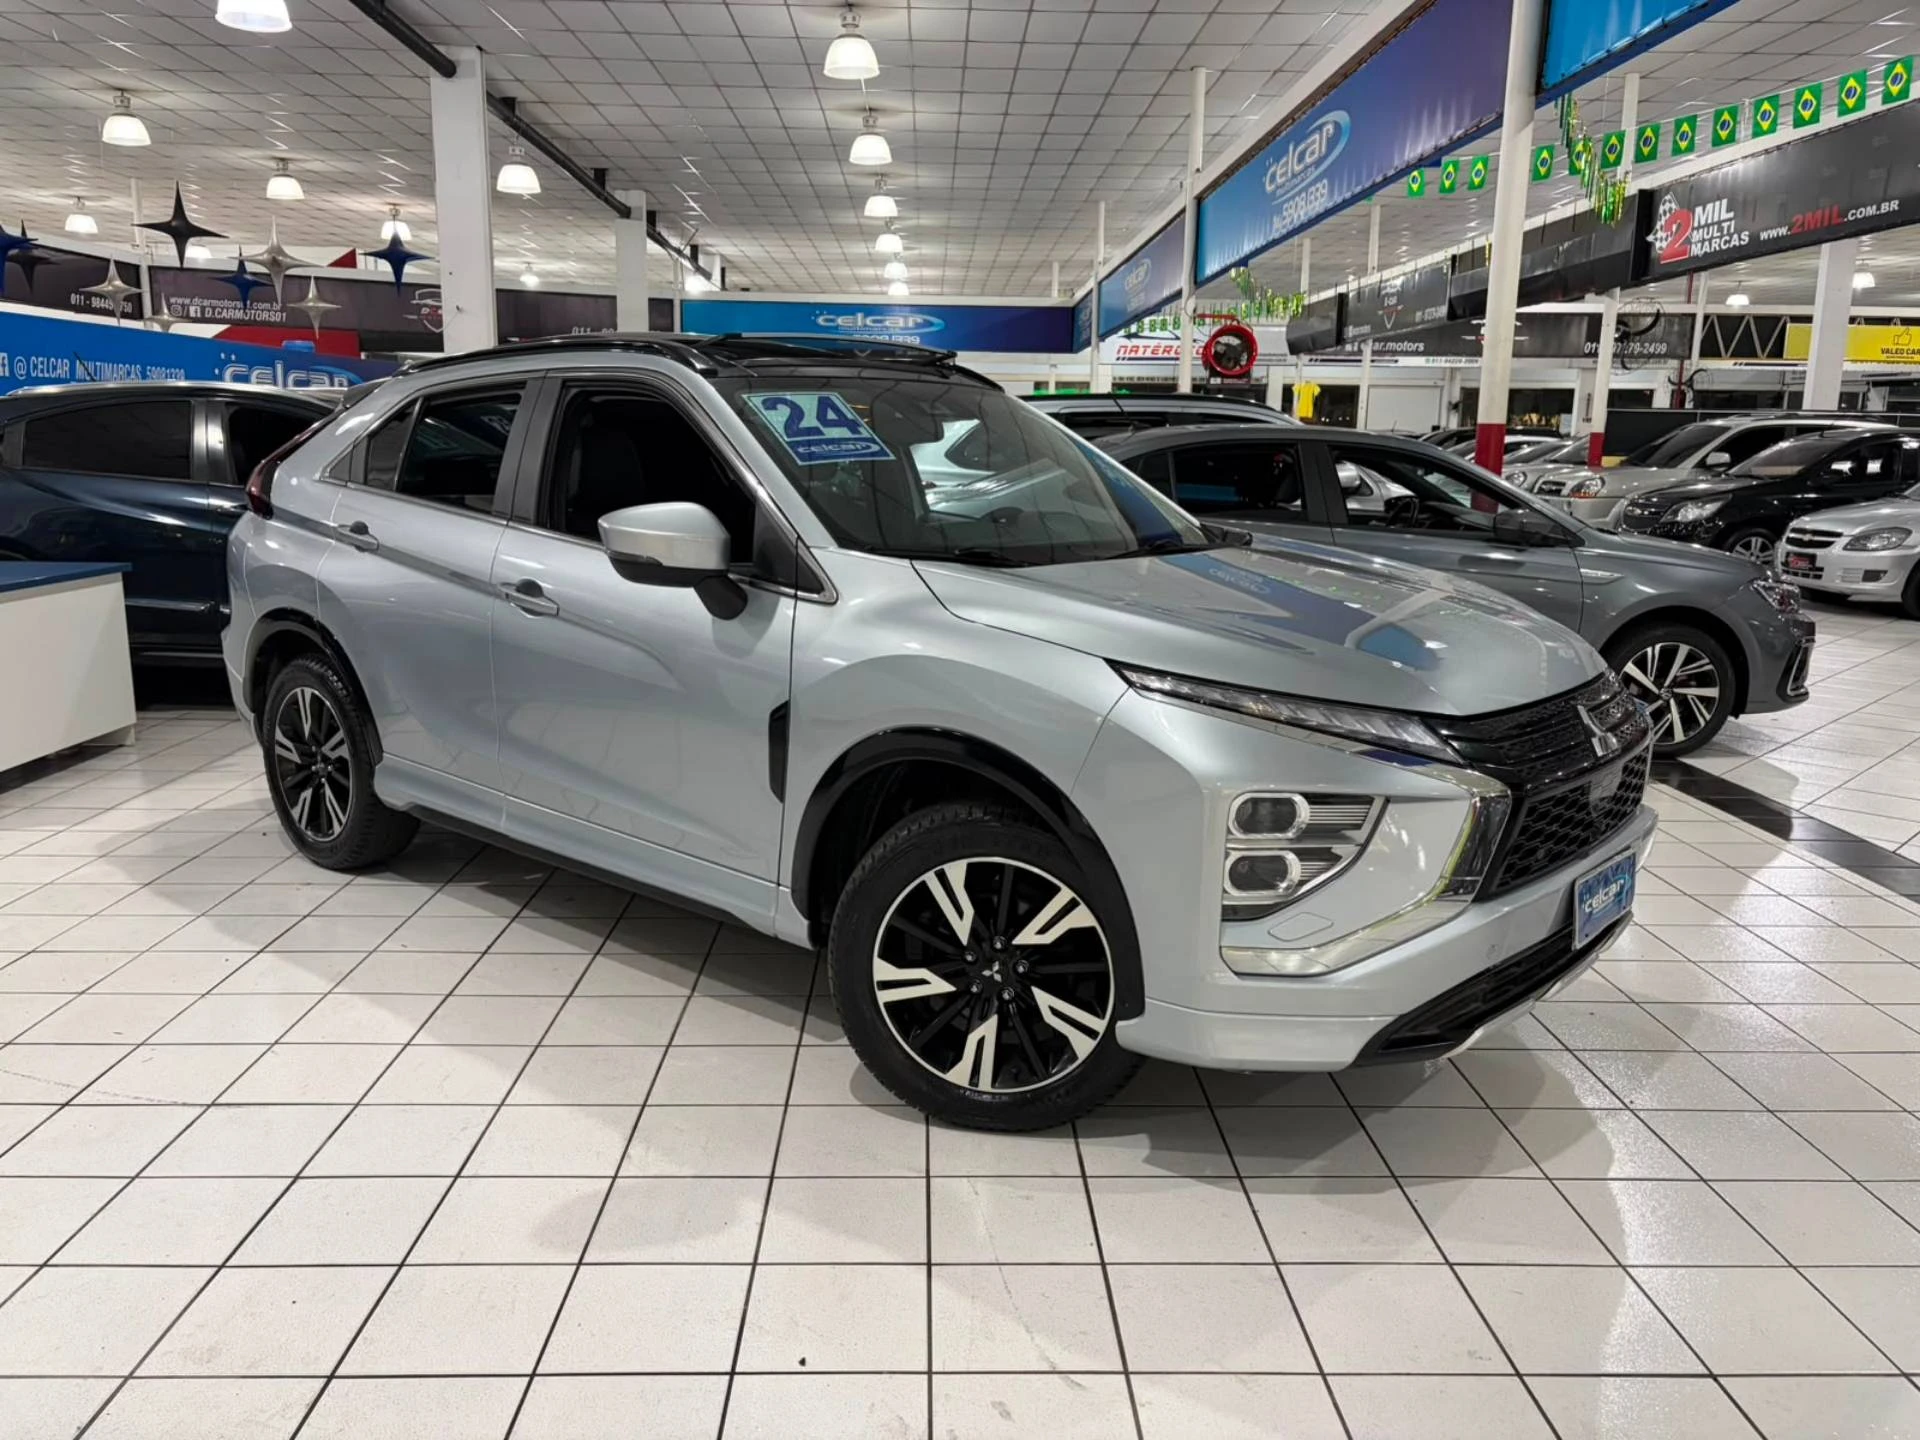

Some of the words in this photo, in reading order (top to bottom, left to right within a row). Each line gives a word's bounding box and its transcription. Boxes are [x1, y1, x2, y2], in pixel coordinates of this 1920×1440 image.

[1265, 121, 1336, 194] celcar
[1660, 208, 1693, 264] 2
[1693, 198, 1735, 228] MIL
[1690, 232, 1750, 256] MARCAS
[1691, 221, 1735, 243] MULTI
[816, 312, 924, 328] celcar
[30, 356, 70, 379] CELCAR
[222, 360, 349, 390] celcar
[761, 395, 864, 438] 24
[1585, 879, 1625, 913] celcar
